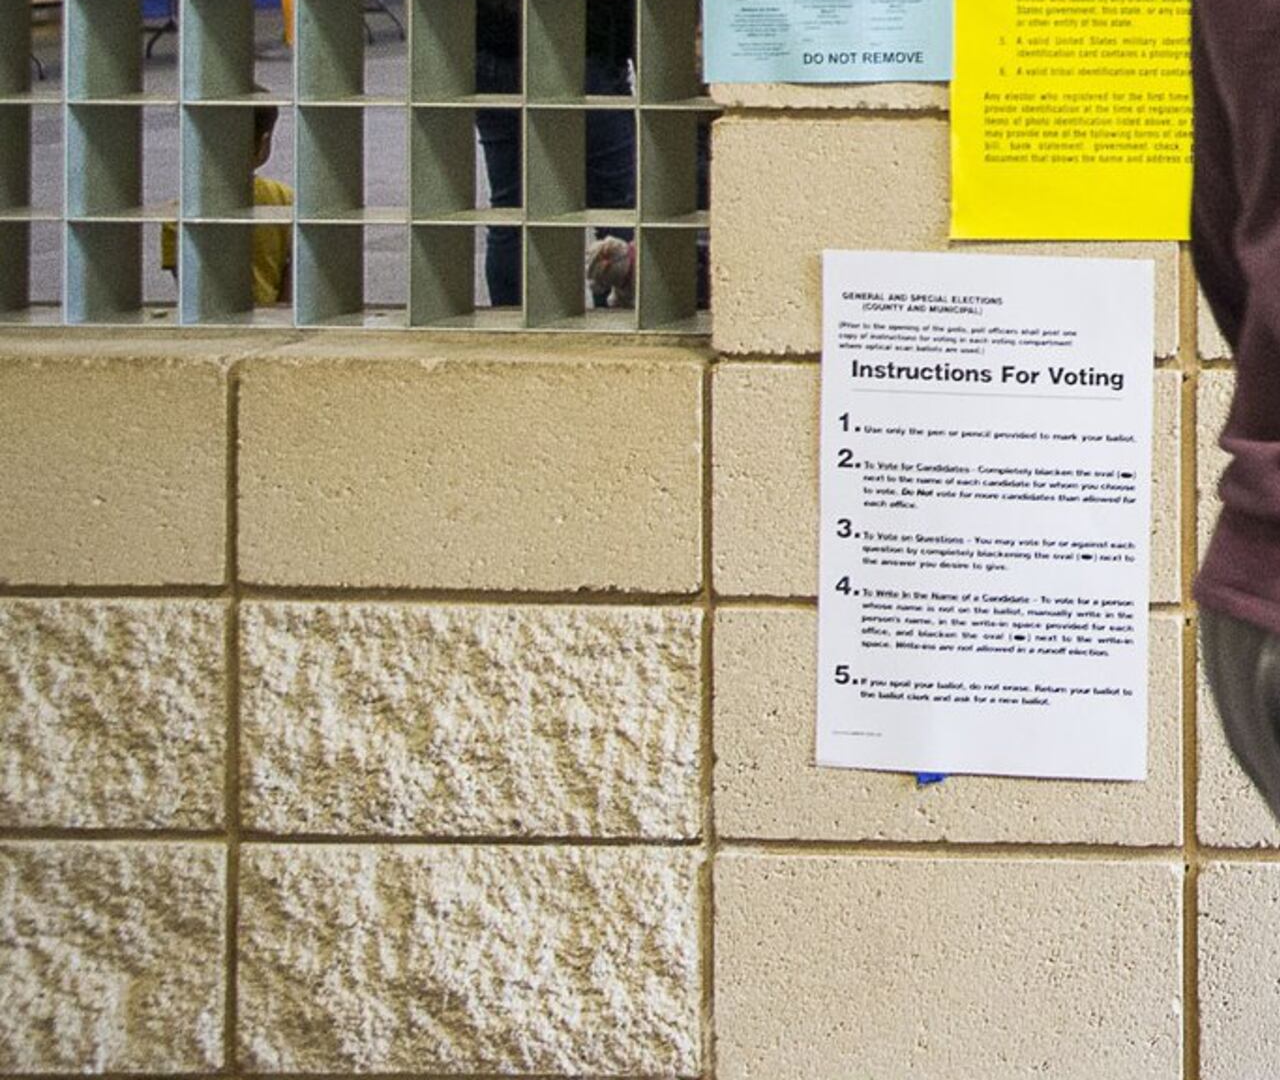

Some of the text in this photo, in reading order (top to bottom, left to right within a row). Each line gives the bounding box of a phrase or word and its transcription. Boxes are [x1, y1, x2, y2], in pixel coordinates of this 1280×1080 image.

[803, 51, 923, 65] DO NOT REMOVE
[842, 292, 1003, 305] GENERAL AND SPECIAL ELECTIONS
[852, 360, 1124, 390] Instructions For Voting
